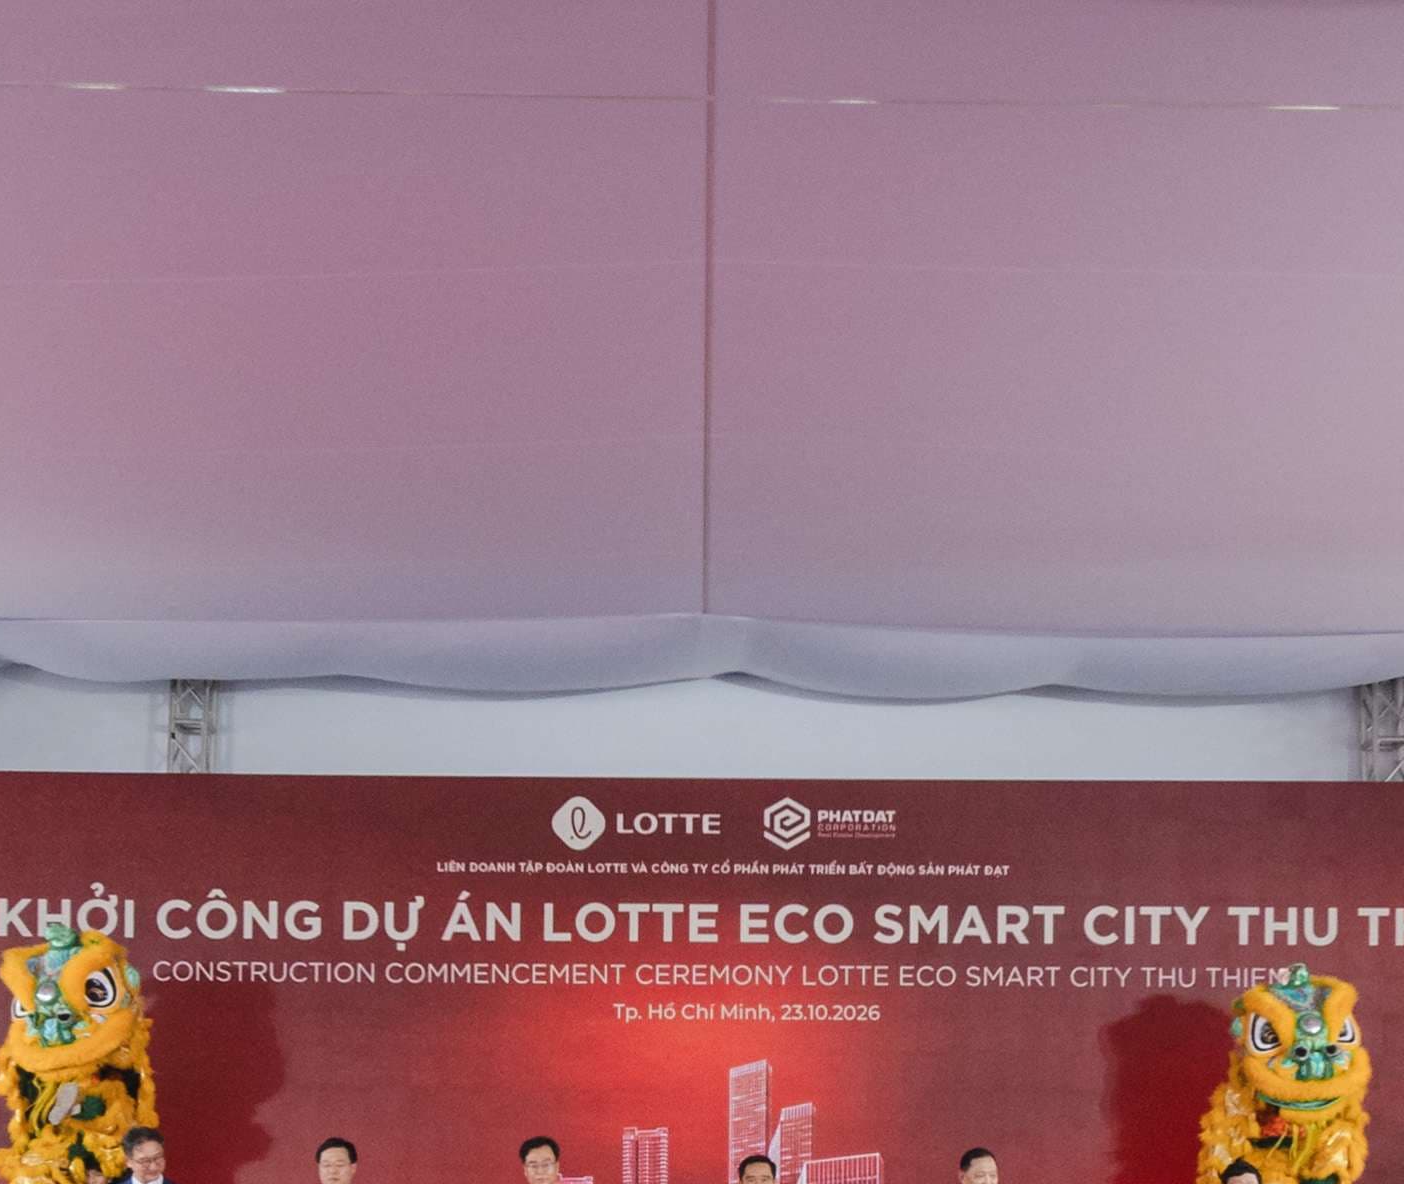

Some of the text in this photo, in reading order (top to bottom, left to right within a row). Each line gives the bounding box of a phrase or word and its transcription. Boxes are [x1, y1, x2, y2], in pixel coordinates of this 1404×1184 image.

[616, 812, 721, 835] LOTTE
[817, 810, 896, 823] PHATDAT
[817, 823, 896, 832] CORPORATION
[437, 859, 465, 873] LIÊN
[469, 861, 516, 873] DOANH
[518, 859, 543, 876] TẬP
[545, 859, 584, 873] ĐOÀN
[587, 862, 628, 874] LOTTE
[631, 859, 648, 874] VÀ
[651, 859, 689, 875] CÔNG
[692, 863, 708, 875] TY
[772, 862, 805, 875] PHÁT
[947, 863, 981, 876] PHÁT
[983, 864, 1010, 879] ĐẠT
[156, 887, 323, 942] CÔNG
[342, 894, 426, 953] DỰ
[441, 890, 522, 942] ÁN
[542, 901, 719, 944] LOTTE
[739, 902, 854, 944] ECO
[873, 902, 1065, 945] SMART
[1083, 904, 1211, 946] CITY
[1227, 906, 1339, 946] THU
[152, 958, 375, 984] CONSTRUCTION
[384, 960, 624, 986] COMMENCEMENT
[635, 962, 792, 987] CEREMONY
[802, 964, 889, 987] LOTTE
[899, 965, 957, 987] ECO
[965, 965, 1062, 988] SMART
[1069, 966, 1132, 988] CITY
[1141, 966, 1197, 988] THU
[613, 1003, 642, 1024] Tp.
[681, 1002, 716, 1020] Chí
[720, 1003, 776, 1024] Minh,
[780, 1003, 880, 1021] 23.10.2026
